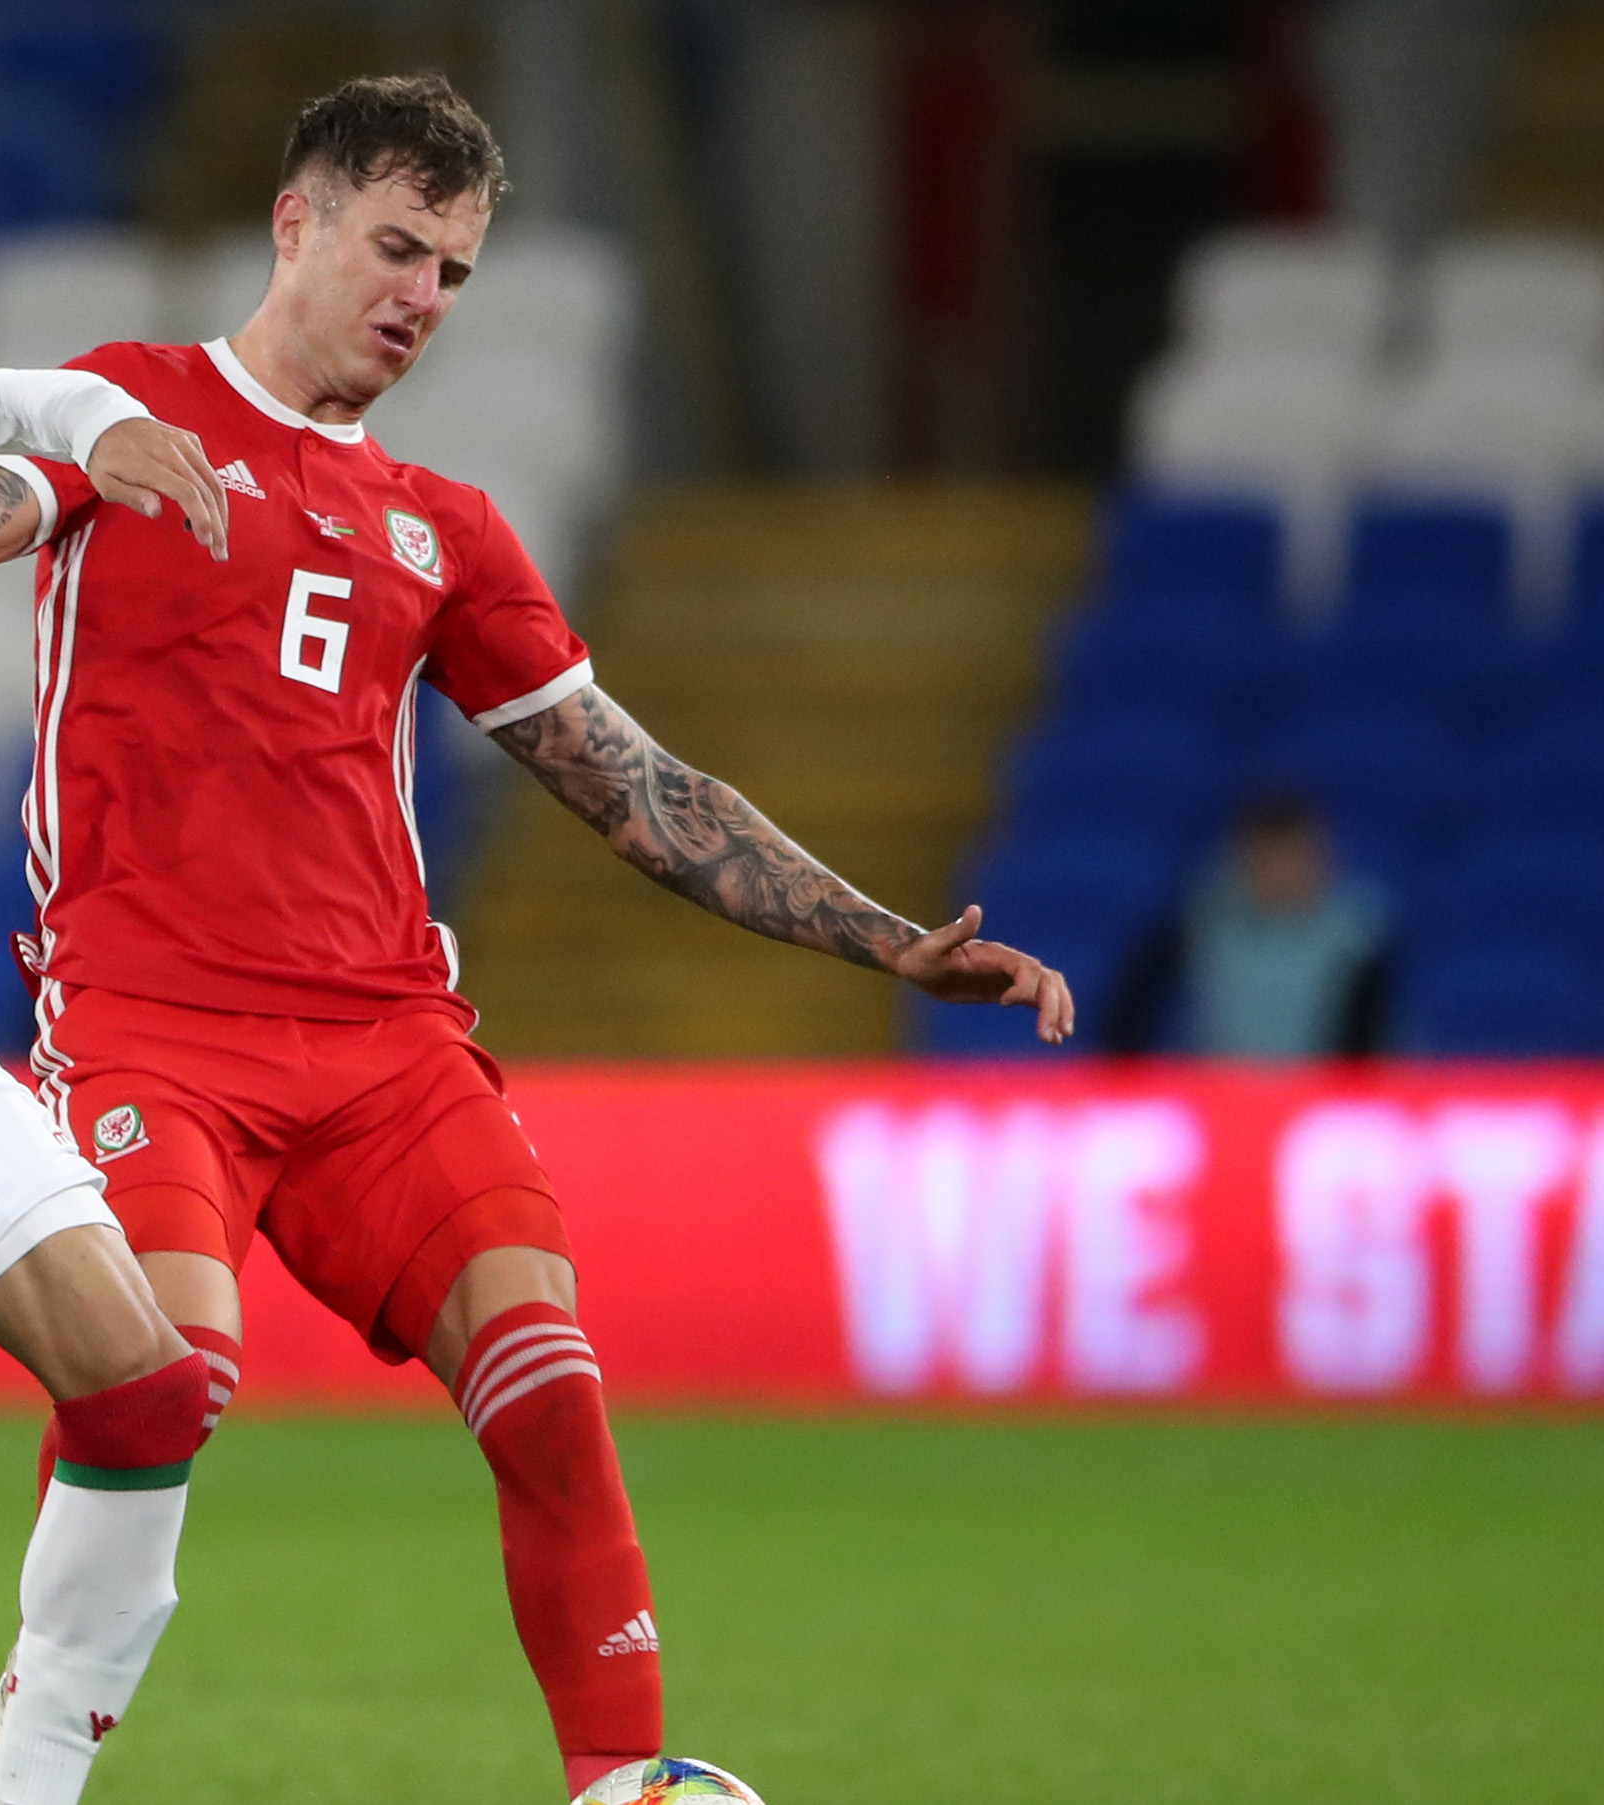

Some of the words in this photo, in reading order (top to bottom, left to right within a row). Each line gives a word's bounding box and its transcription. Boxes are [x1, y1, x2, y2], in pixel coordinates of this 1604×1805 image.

[220, 477, 267, 500] didas
[280, 568, 352, 694] 6
[812, 1098, 1204, 1397] WE
